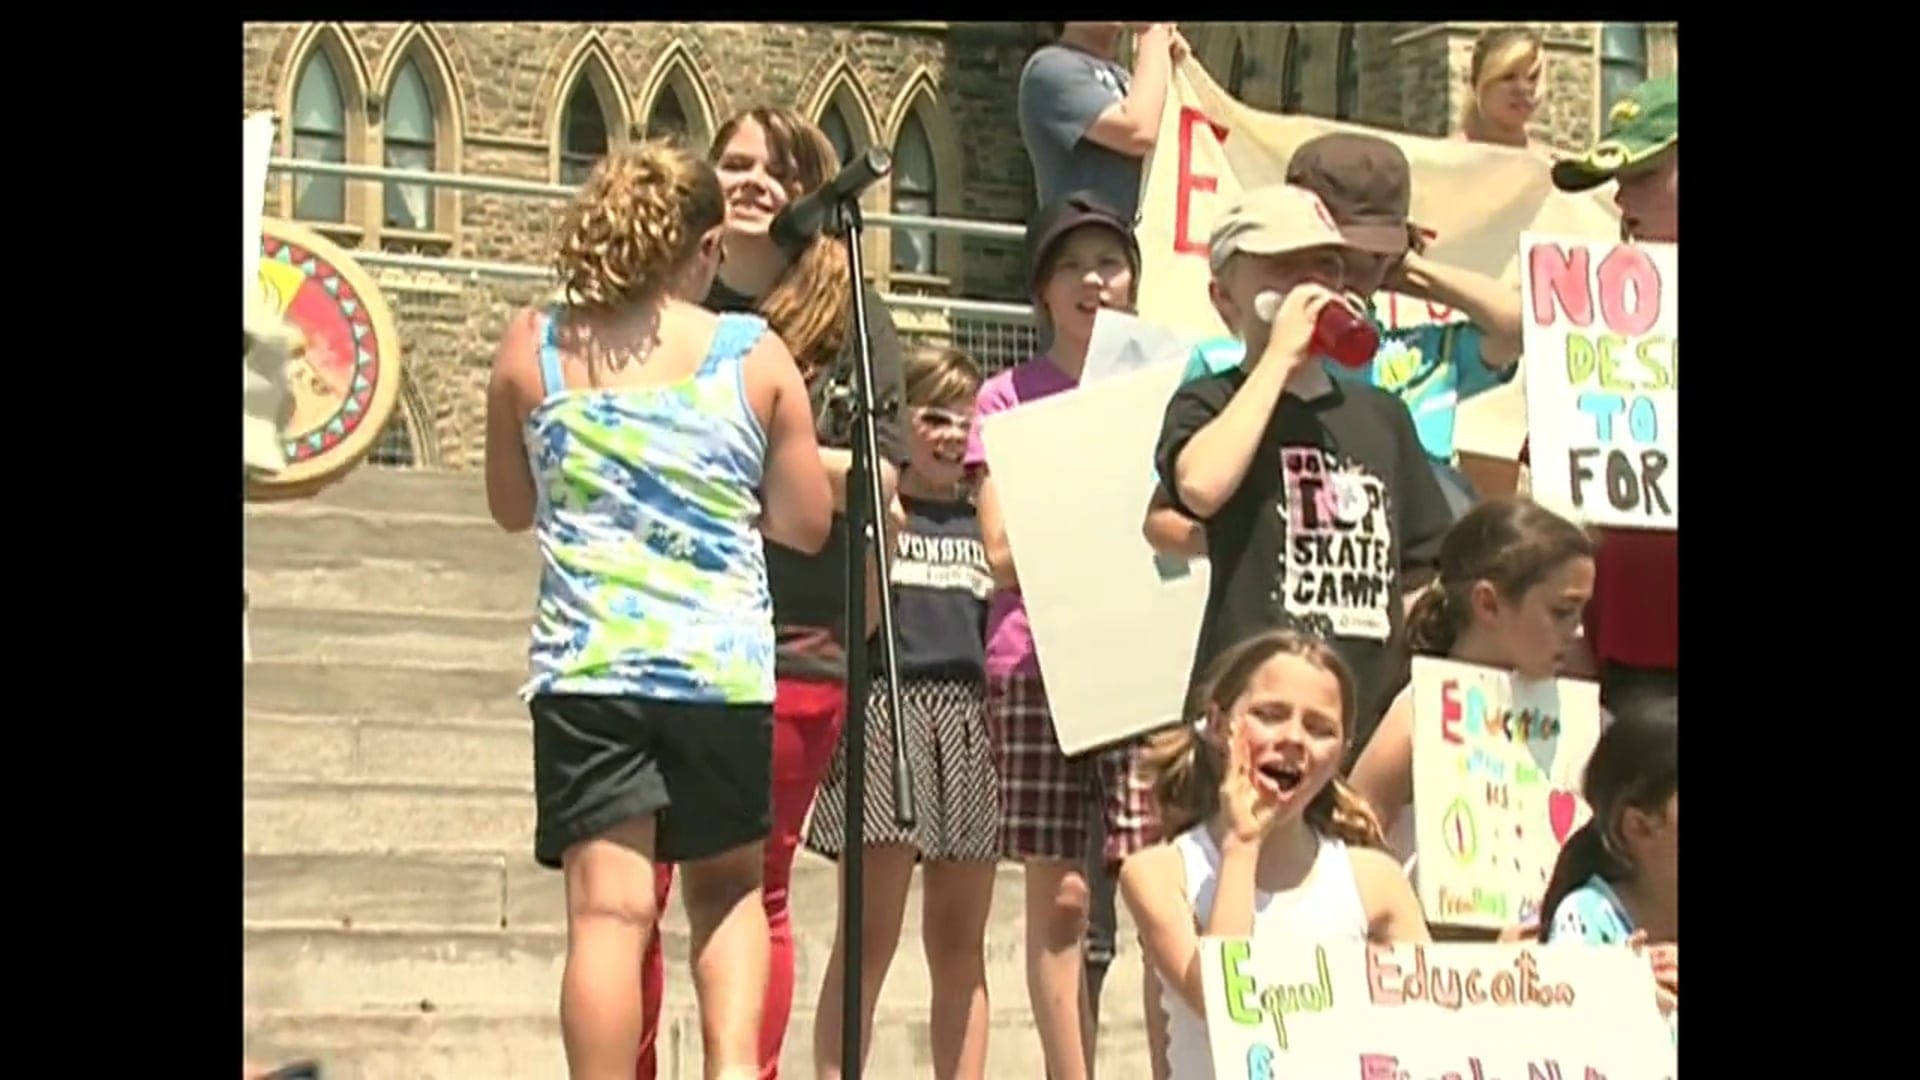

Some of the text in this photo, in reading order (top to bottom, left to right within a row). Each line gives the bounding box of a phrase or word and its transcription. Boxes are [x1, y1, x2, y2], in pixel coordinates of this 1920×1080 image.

[1529, 243, 1662, 337] NO
[1577, 393, 1658, 442] TO
[1569, 447, 1671, 516] FOR
[1293, 535, 1386, 575] SKATE
[1293, 570, 1384, 609] CAMP
[1221, 940, 1575, 1051] Equal Education
